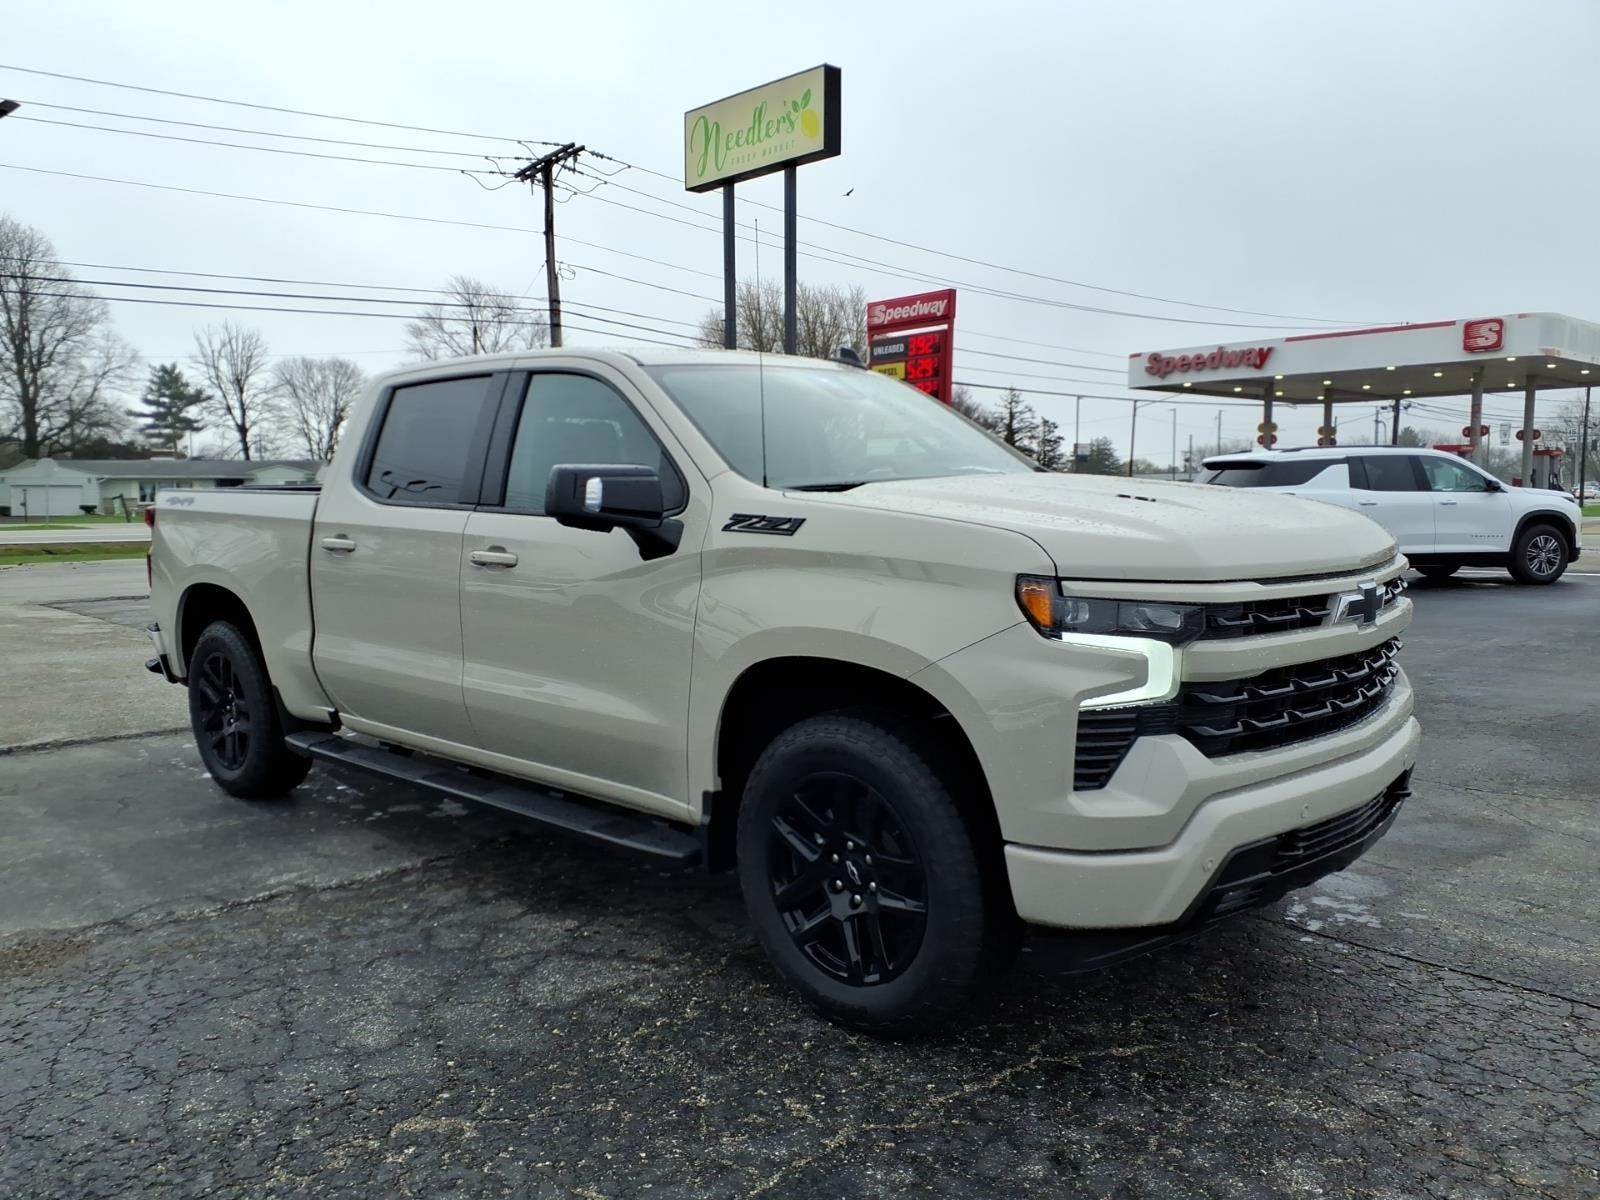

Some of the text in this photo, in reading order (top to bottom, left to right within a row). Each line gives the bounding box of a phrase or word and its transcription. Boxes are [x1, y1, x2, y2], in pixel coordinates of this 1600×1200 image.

[690, 100, 797, 178] Needler's
[871, 299, 948, 324] Speedway
[873, 343, 905, 356] UNLEADED
[1145, 346, 1275, 380] Speedway
[721, 513, 807, 536] Z71
